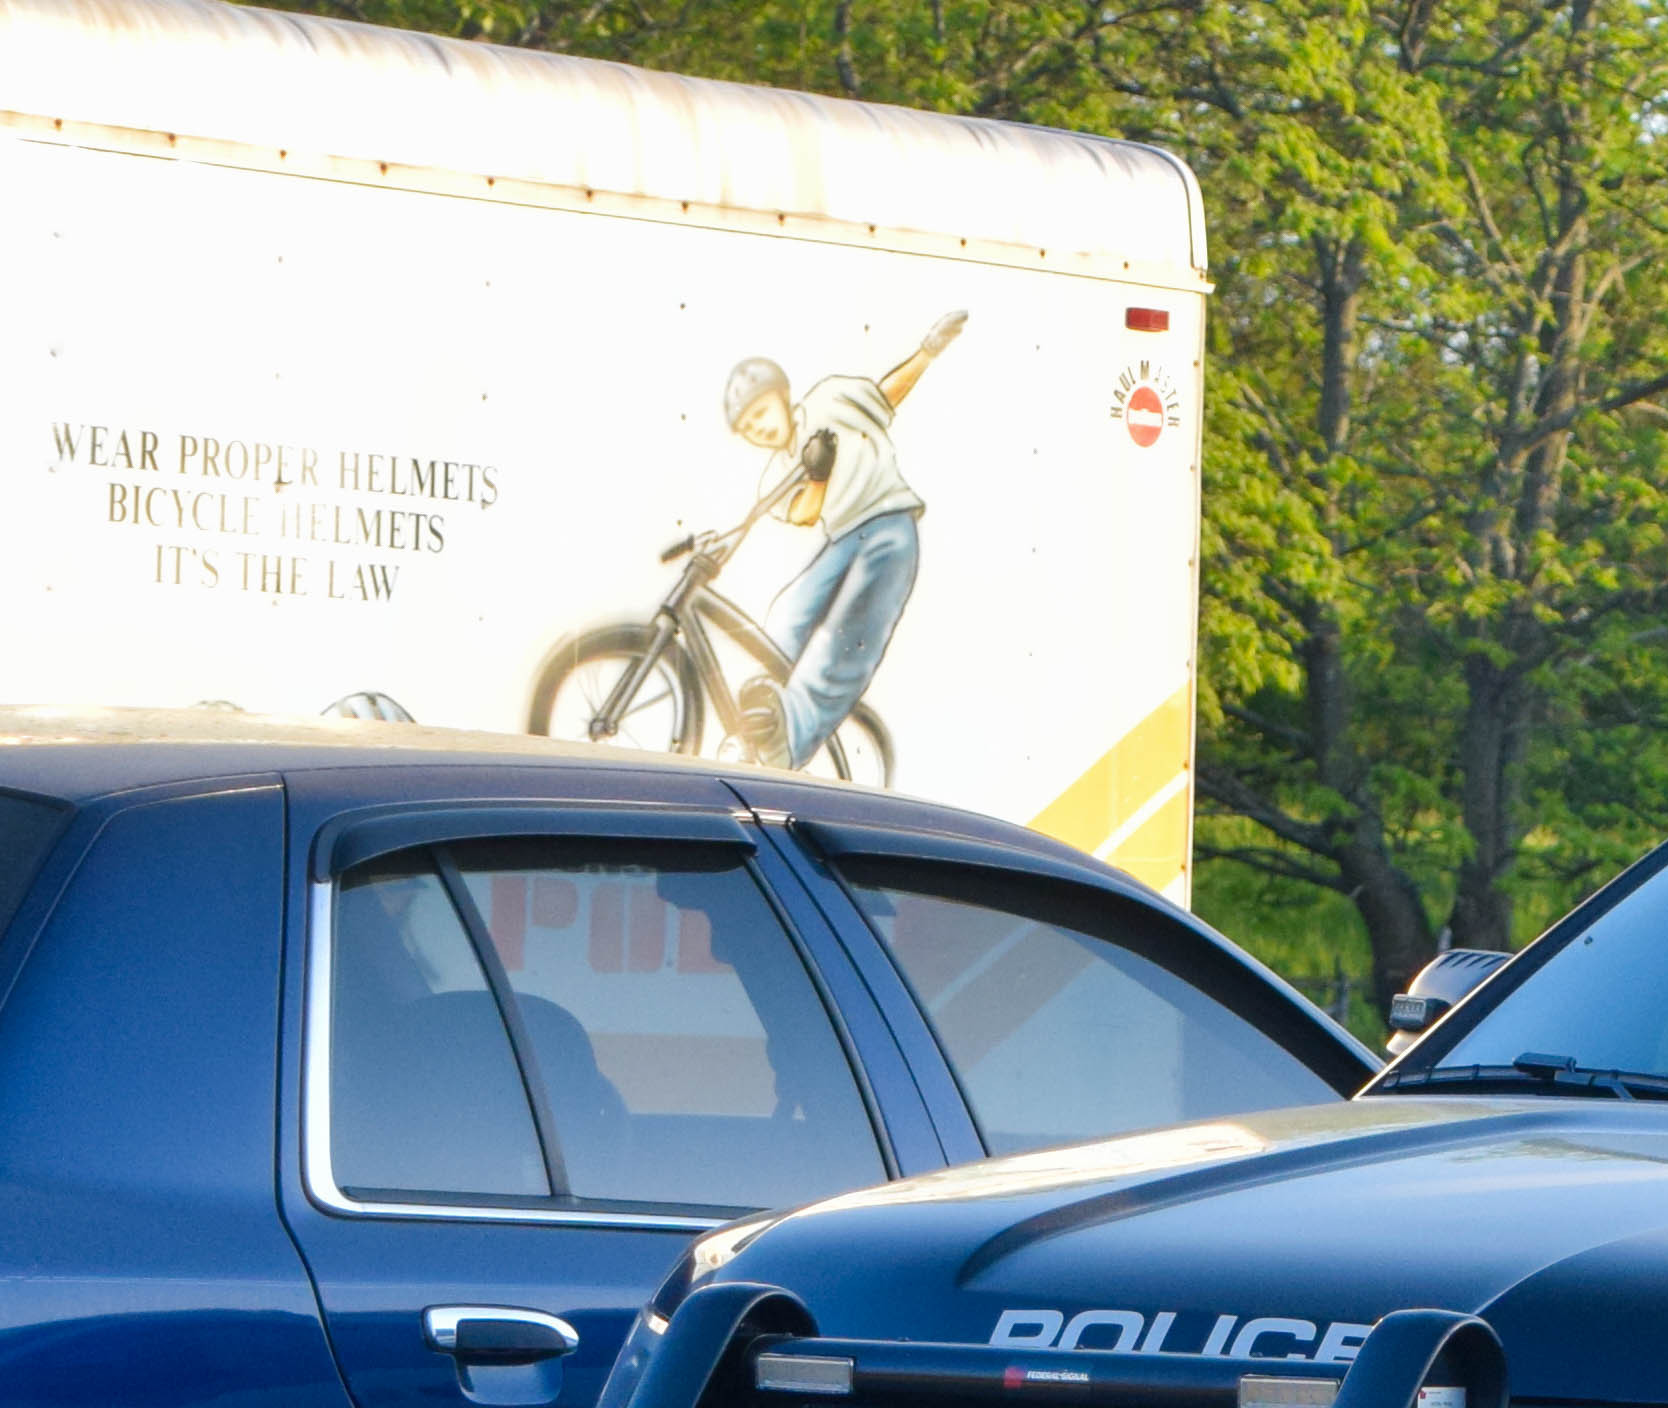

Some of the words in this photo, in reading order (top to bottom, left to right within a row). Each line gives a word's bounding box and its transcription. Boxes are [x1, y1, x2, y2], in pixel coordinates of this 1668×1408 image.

[51, 421, 160, 472] WEAR
[178, 433, 320, 486] PROPER
[338, 450, 500, 506] HELMETS
[107, 481, 261, 537] BICYCLE
[280, 500, 446, 554] HELMETS
[153, 543, 221, 589] IT'S
[235, 550, 308, 597] THE
[327, 559, 401, 602] LAW
[989, 1308, 1374, 1363] POLICE
